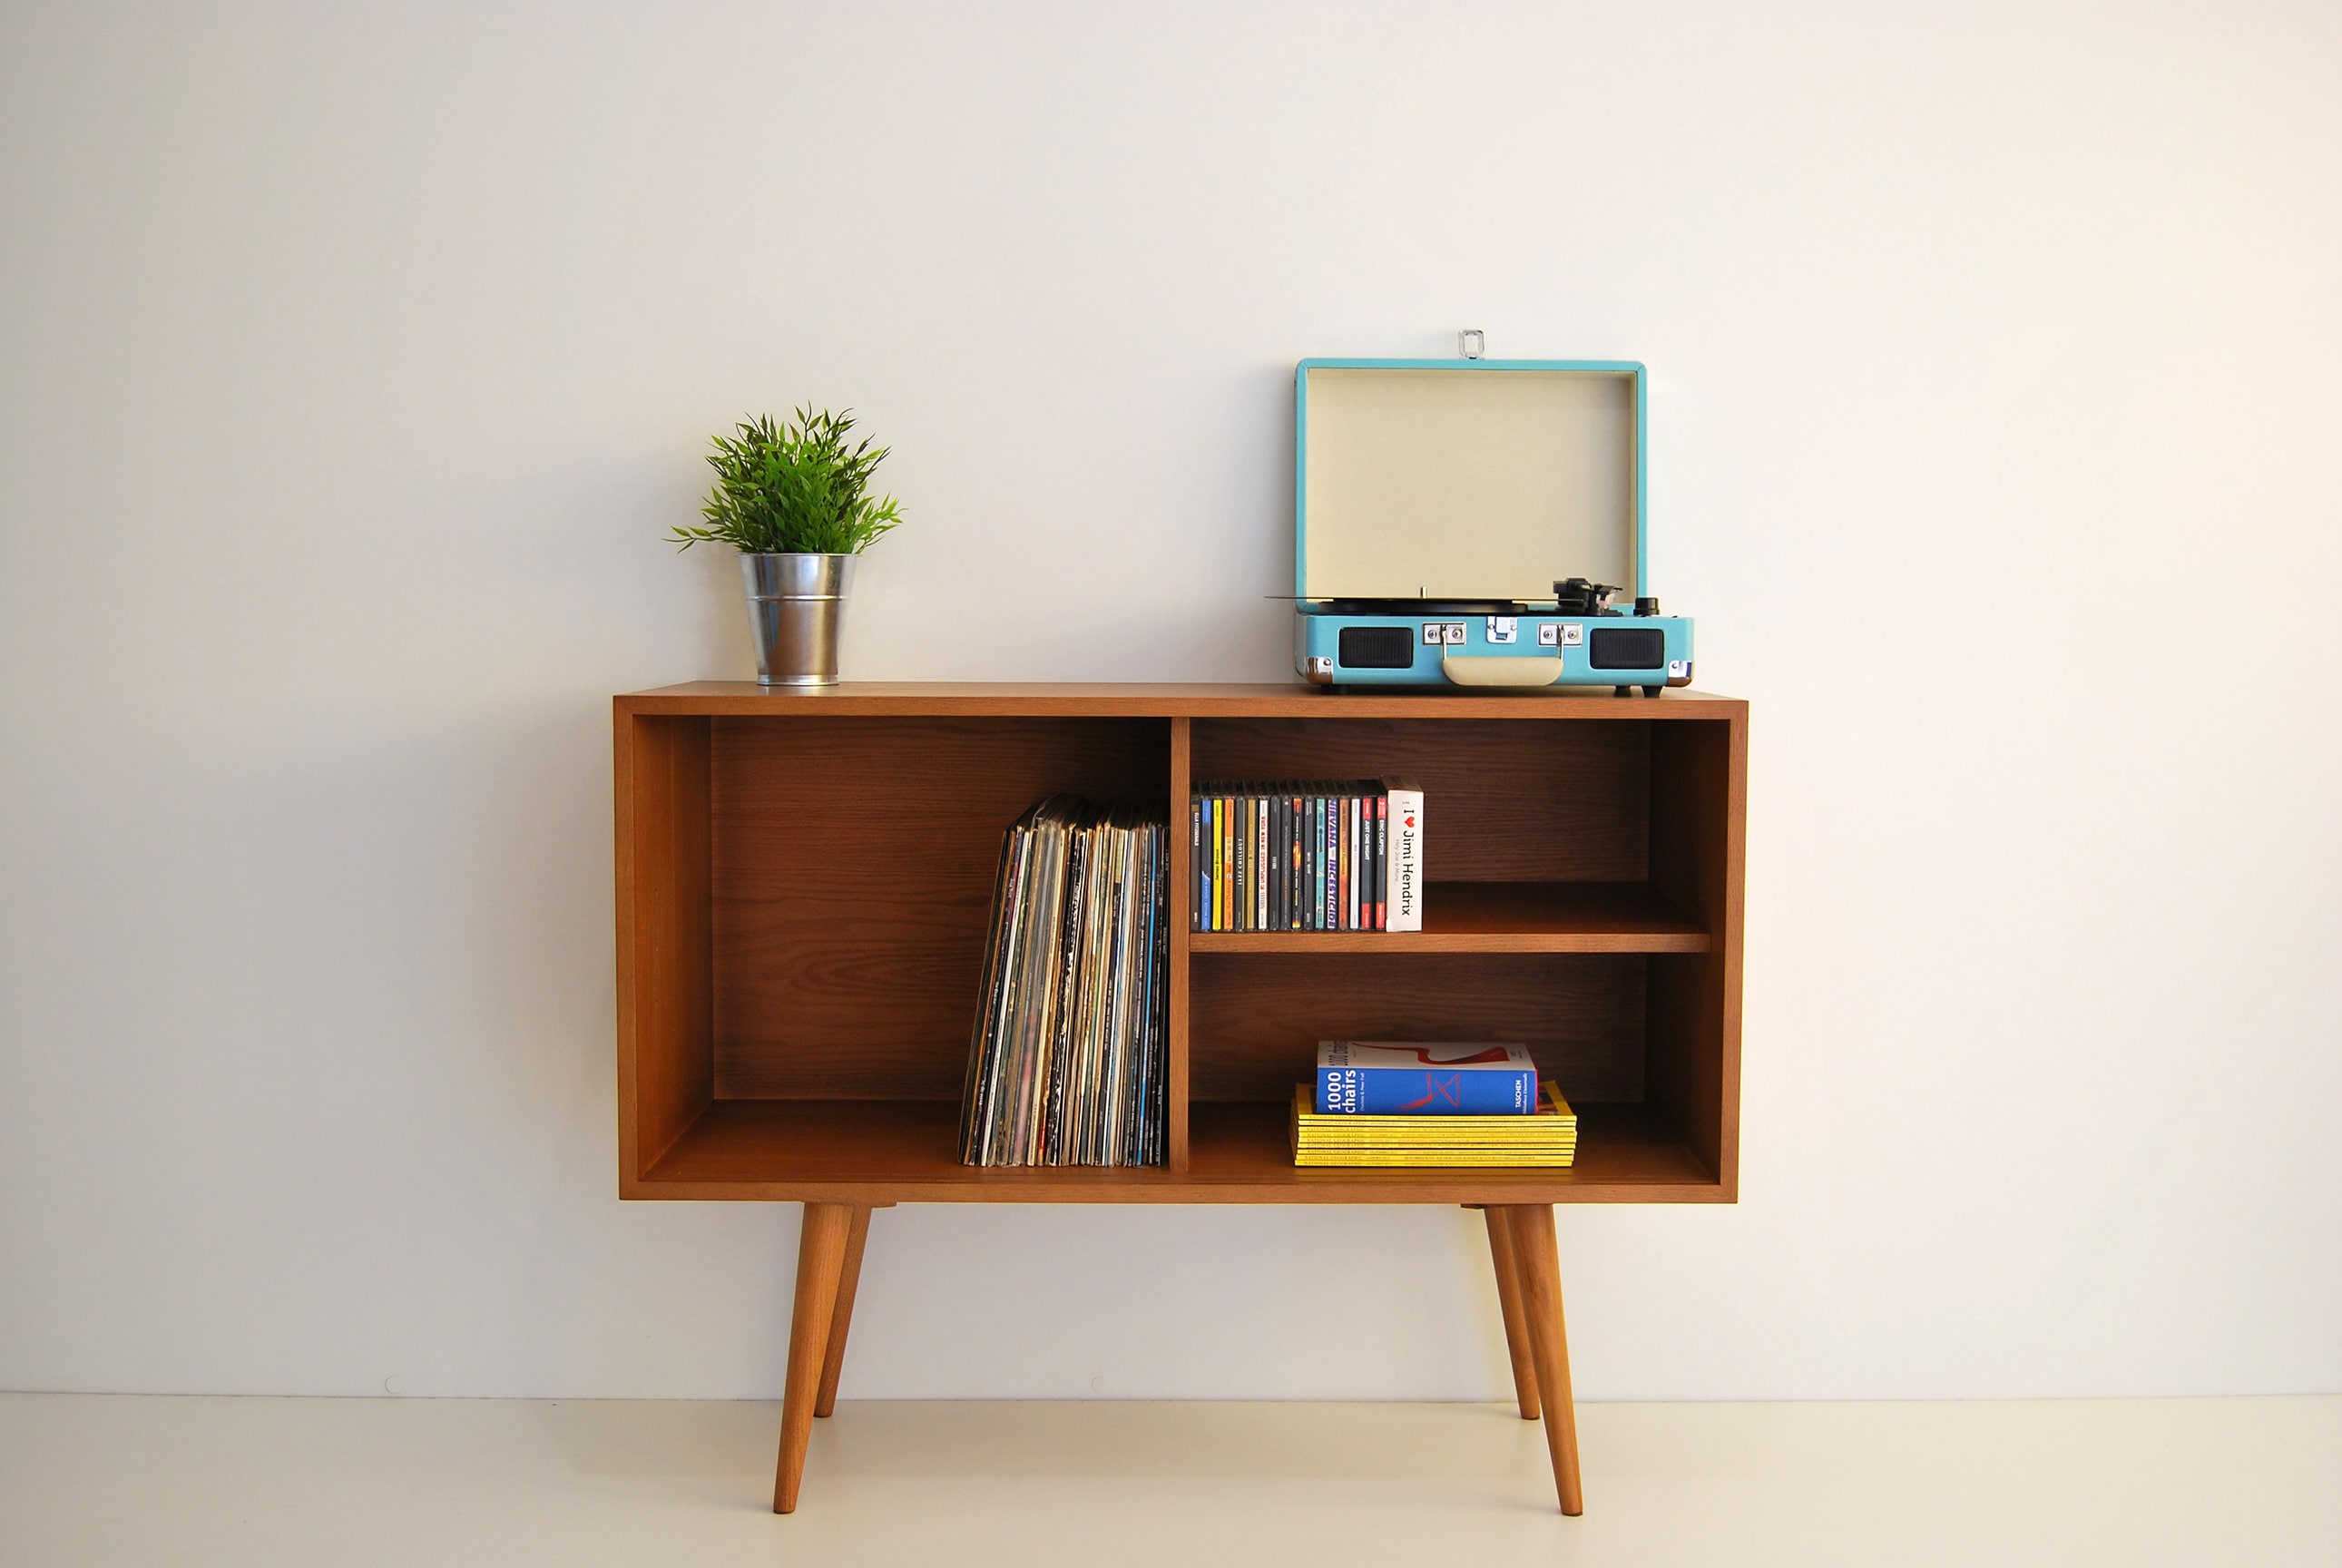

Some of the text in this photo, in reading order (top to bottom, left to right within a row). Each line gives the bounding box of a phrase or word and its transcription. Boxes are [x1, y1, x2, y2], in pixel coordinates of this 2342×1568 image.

[1403, 830, 1415, 859] Jimi
[1402, 864, 1414, 916] Hendrix
[1328, 1072, 1342, 1111] 1000
[1342, 1070, 1357, 1113] chairs
